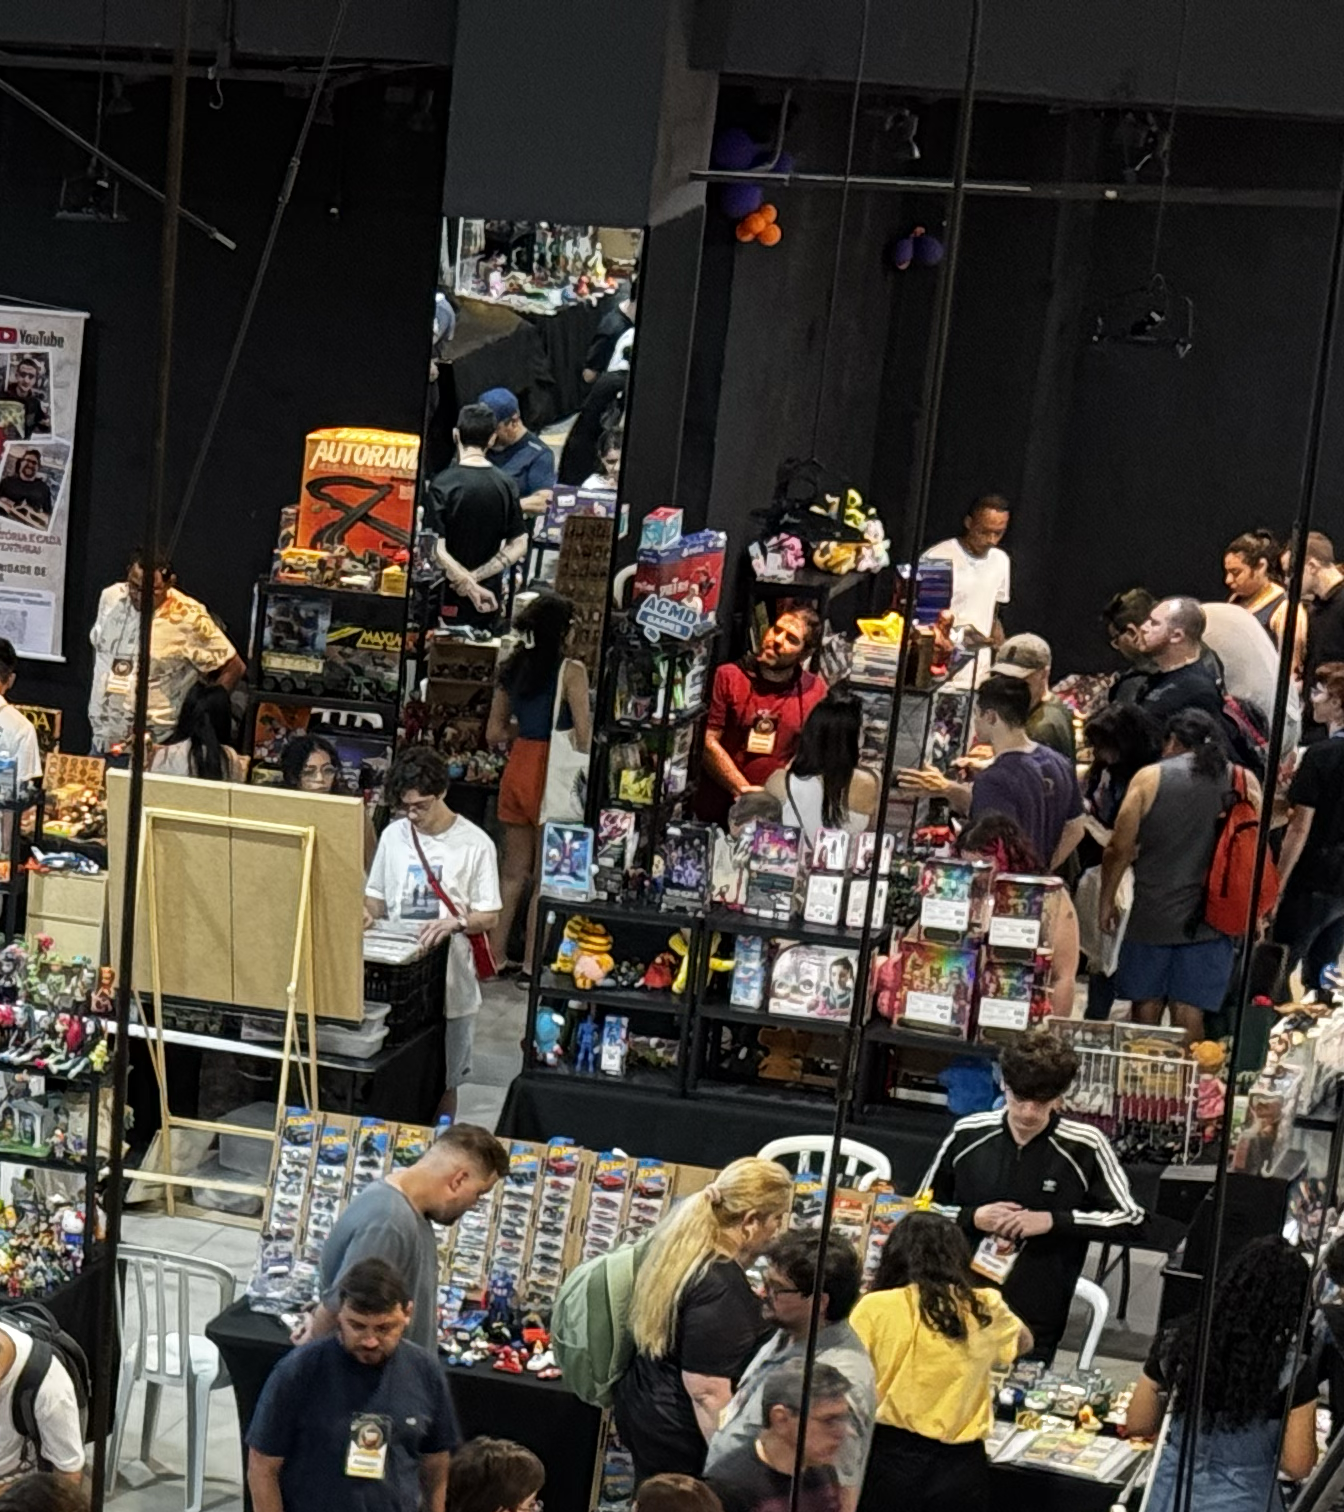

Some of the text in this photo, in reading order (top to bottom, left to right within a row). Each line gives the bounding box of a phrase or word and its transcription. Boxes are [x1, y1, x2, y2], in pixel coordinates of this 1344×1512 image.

[19, 329, 65, 348] YouTube
[309, 440, 419, 470] AUTORAM
[34, 566, 47, 577] DE
[643, 597, 698, 625] ACMD
